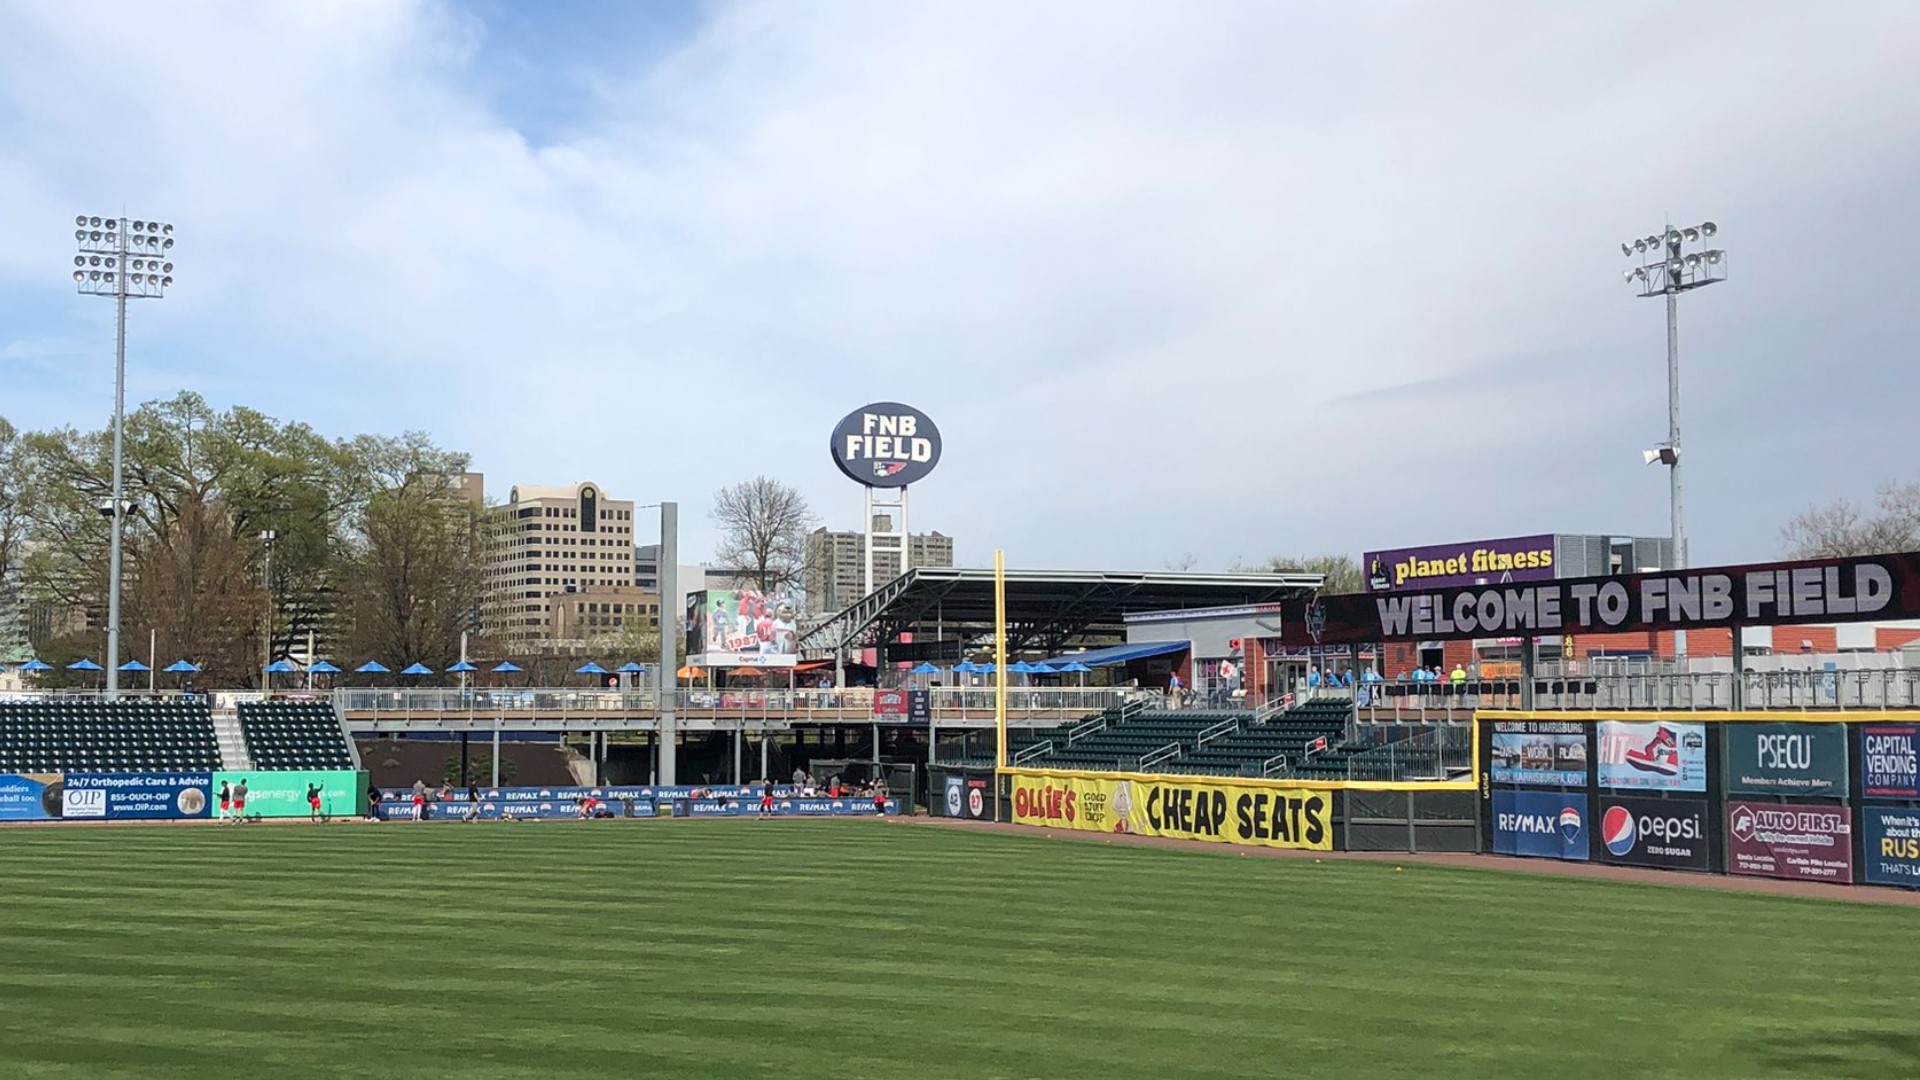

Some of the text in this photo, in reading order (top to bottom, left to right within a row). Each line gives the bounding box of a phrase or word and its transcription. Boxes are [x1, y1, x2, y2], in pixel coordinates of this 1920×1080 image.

[863, 413, 917, 436] FNB
[846, 435, 931, 462] FIELD
[1395, 549, 1553, 584] planet fitness
[1376, 563, 1893, 636] WELCOME TO FNB FIELD
[728, 635, 757, 649] 1987
[1494, 722, 1584, 733] WELCOME TO HARRISBURG
[1757, 734, 1811, 769] PSECU
[1866, 735, 1917, 754] CAPITAL
[1526, 746, 1550, 758] WORK
[1867, 755, 1917, 774] VENDING
[67, 777, 209, 788] 24/7 Orthopedic Care & Advice
[1482, 772, 1490, 799] 355
[1741, 777, 1833, 787] Members Achieve More
[1867, 774, 1917, 786] COMPANY
[69, 790, 101, 805] OIP
[110, 793, 171, 802] 855-OUCH-OIP
[1015, 785, 1077, 822] OLLIE'S
[1084, 792, 1107, 802] GOOD
[113, 803, 168, 812] www.OIP.com
[693, 804, 727, 812] RE/MAX
[800, 803, 831, 811] RE/MAX
[851, 803, 876, 811] RE/MA
[1084, 802, 1106, 811] STUFF
[1146, 786, 1325, 844] CHEAP SEATS
[1755, 811, 1797, 831] AUTO
[1798, 813, 1841, 833] FIRST
[1881, 815, 1920, 827] When it's
[1498, 813, 1556, 834] RE/MAX
[1638, 814, 1700, 843] pepsi
[1886, 827, 1910, 837] about
[1647, 846, 1692, 857] ZERO SUGAR
[1881, 838, 1920, 858] RUS
[1880, 863, 1911, 875] THAT'S
